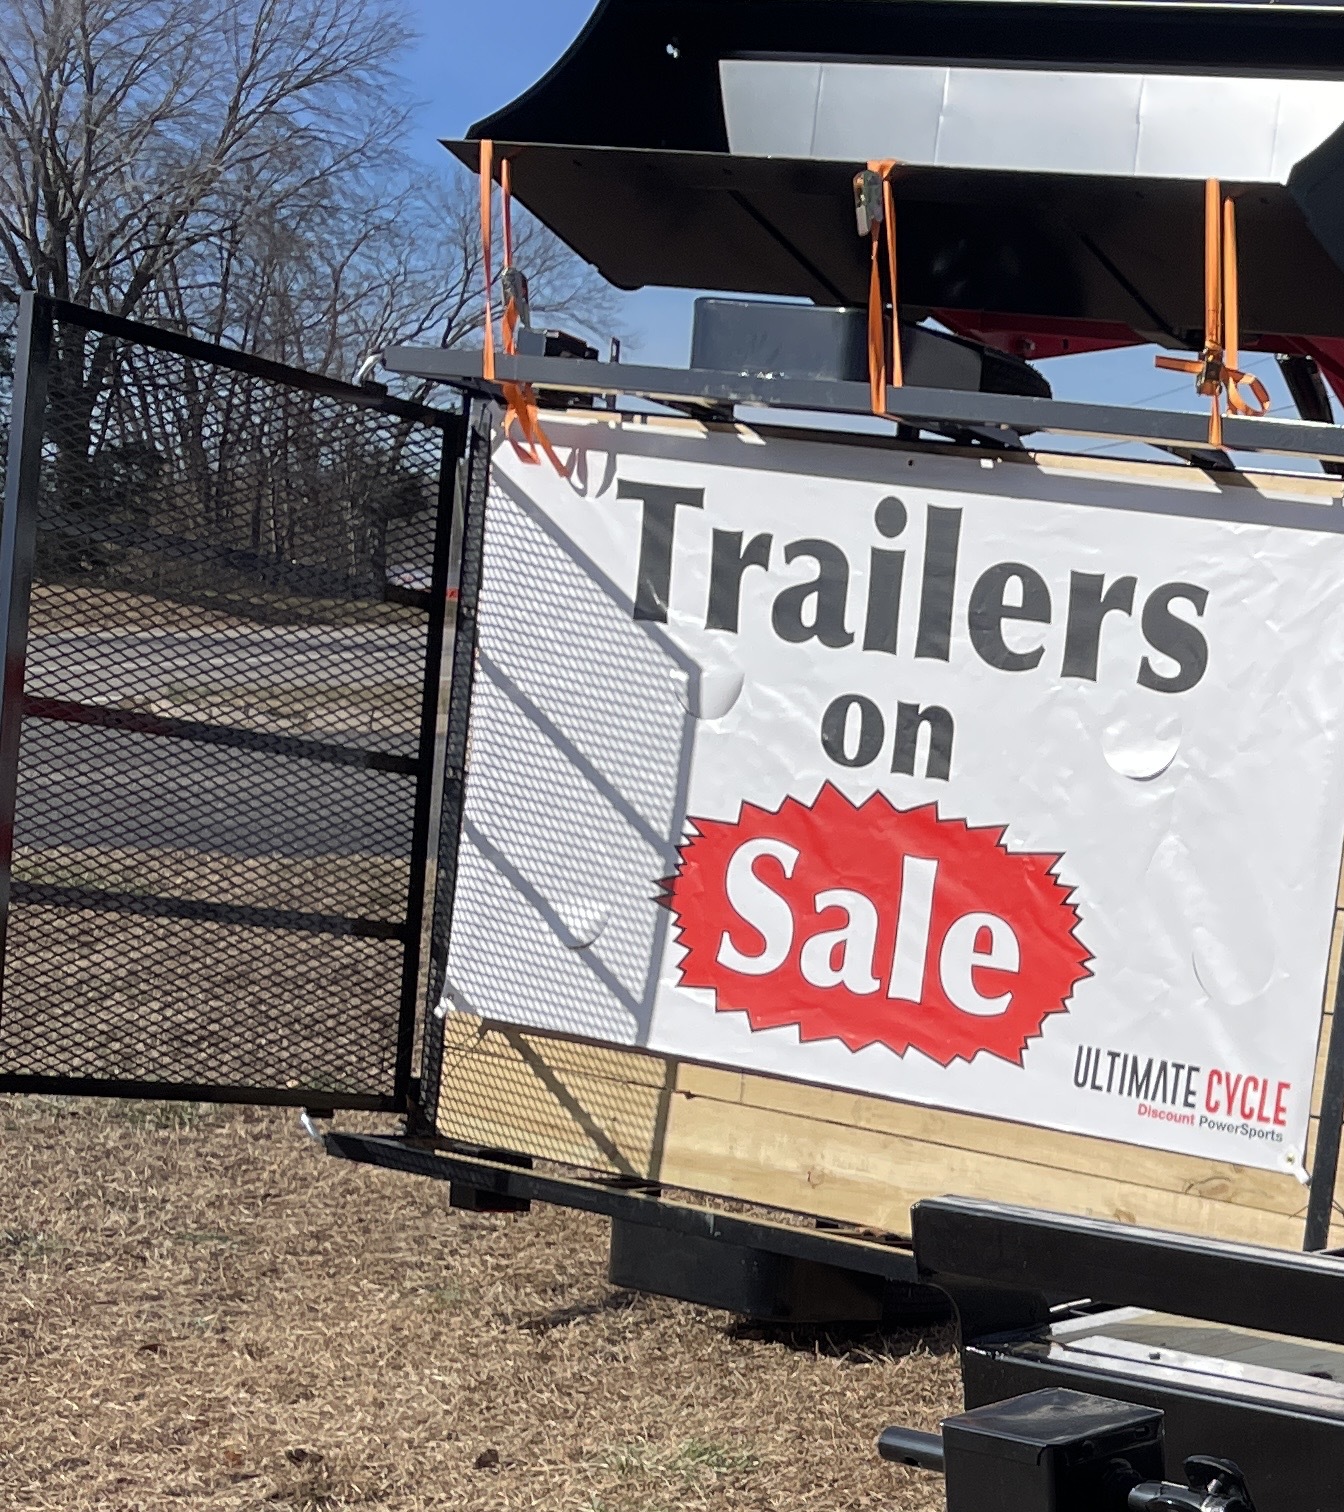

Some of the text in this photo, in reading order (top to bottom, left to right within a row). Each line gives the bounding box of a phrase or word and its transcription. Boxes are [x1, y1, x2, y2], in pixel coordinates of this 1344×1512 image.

[615, 478, 1211, 695] Trailers
[819, 691, 956, 782] on
[714, 835, 1023, 1018] Sale
[1073, 1044, 1291, 1127] ULTIMATE CYCLE
[1137, 1103, 1284, 1143] Discount PowerSports
